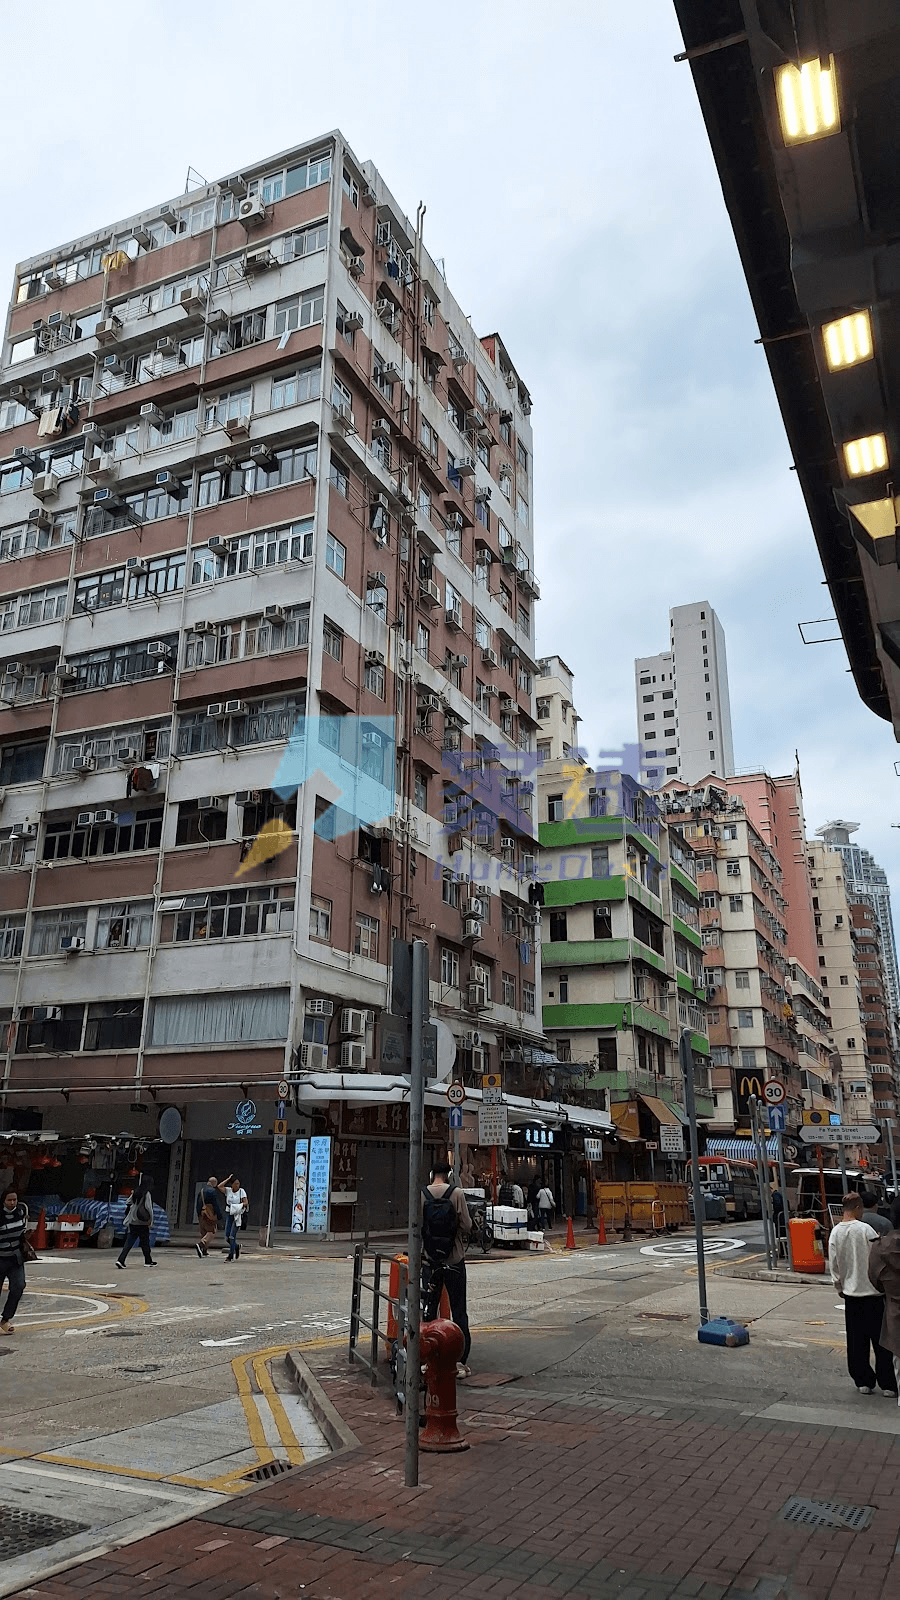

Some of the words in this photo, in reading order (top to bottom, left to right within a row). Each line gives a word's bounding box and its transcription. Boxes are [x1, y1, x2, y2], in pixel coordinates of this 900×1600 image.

[279, 1085, 287, 1093] 30
[766, 1087, 782, 1097] 30
[450, 1090, 462, 1098] 30
